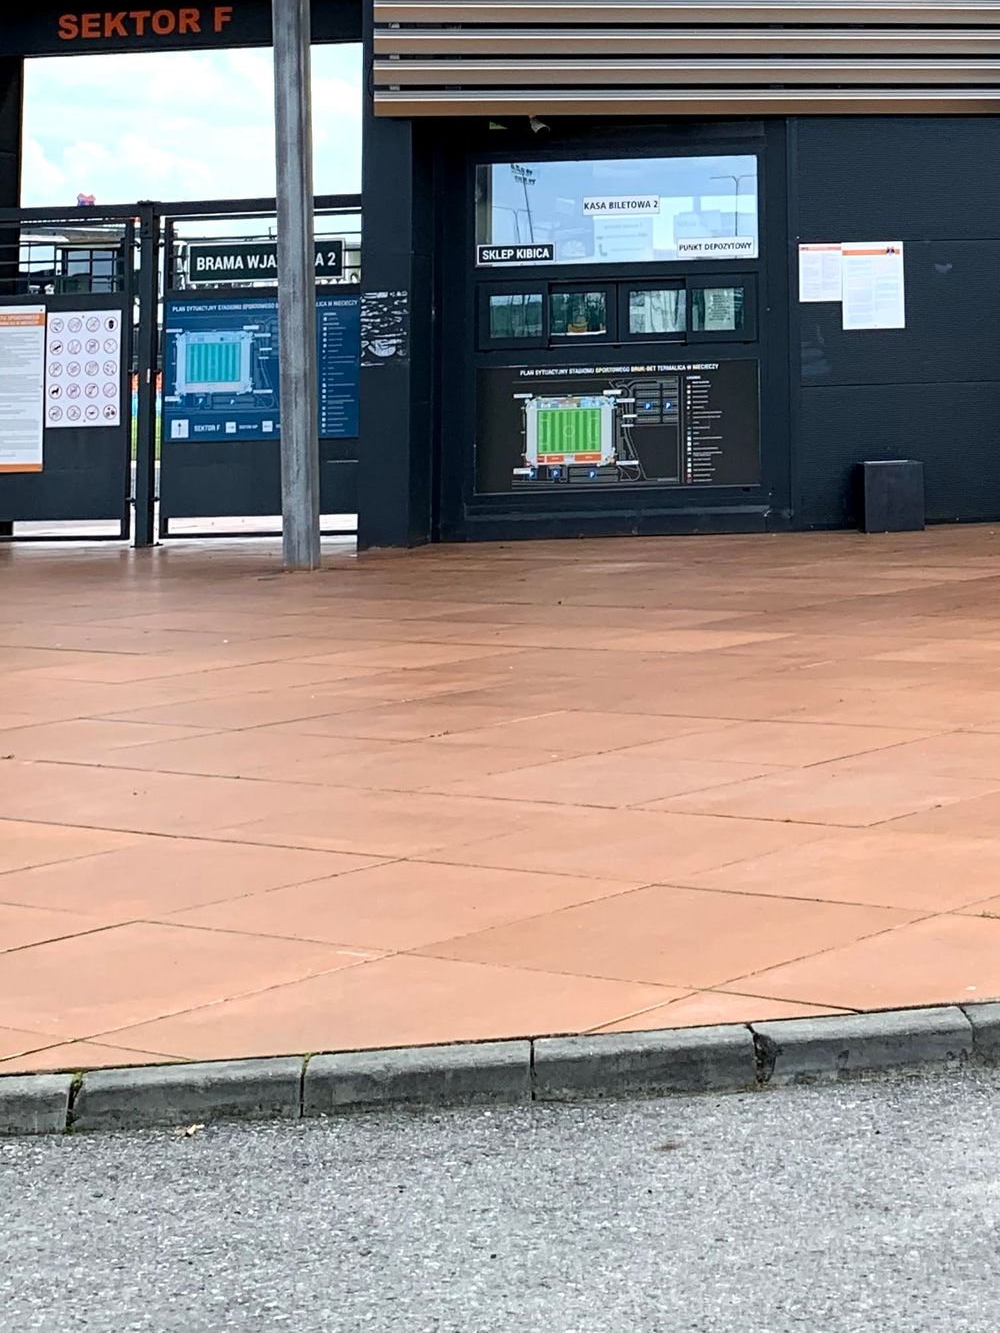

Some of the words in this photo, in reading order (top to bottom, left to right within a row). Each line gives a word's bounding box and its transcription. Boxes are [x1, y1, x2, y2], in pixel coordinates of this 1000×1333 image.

[57, 8, 201, 40] SEKTOR
[213, 6, 233, 33] F
[583, 201, 607, 211] KASA
[609, 200, 651, 210] BILETOWA
[653, 200, 658, 209] 2
[482, 249, 515, 261] SKLEP
[516, 247, 550, 259] KIBICA
[678, 243, 703, 252] PUNKT
[704, 242, 752, 251] DEPOZYTOWY
[196, 254, 244, 271] BRAMA
[327, 251, 336, 266] 2
